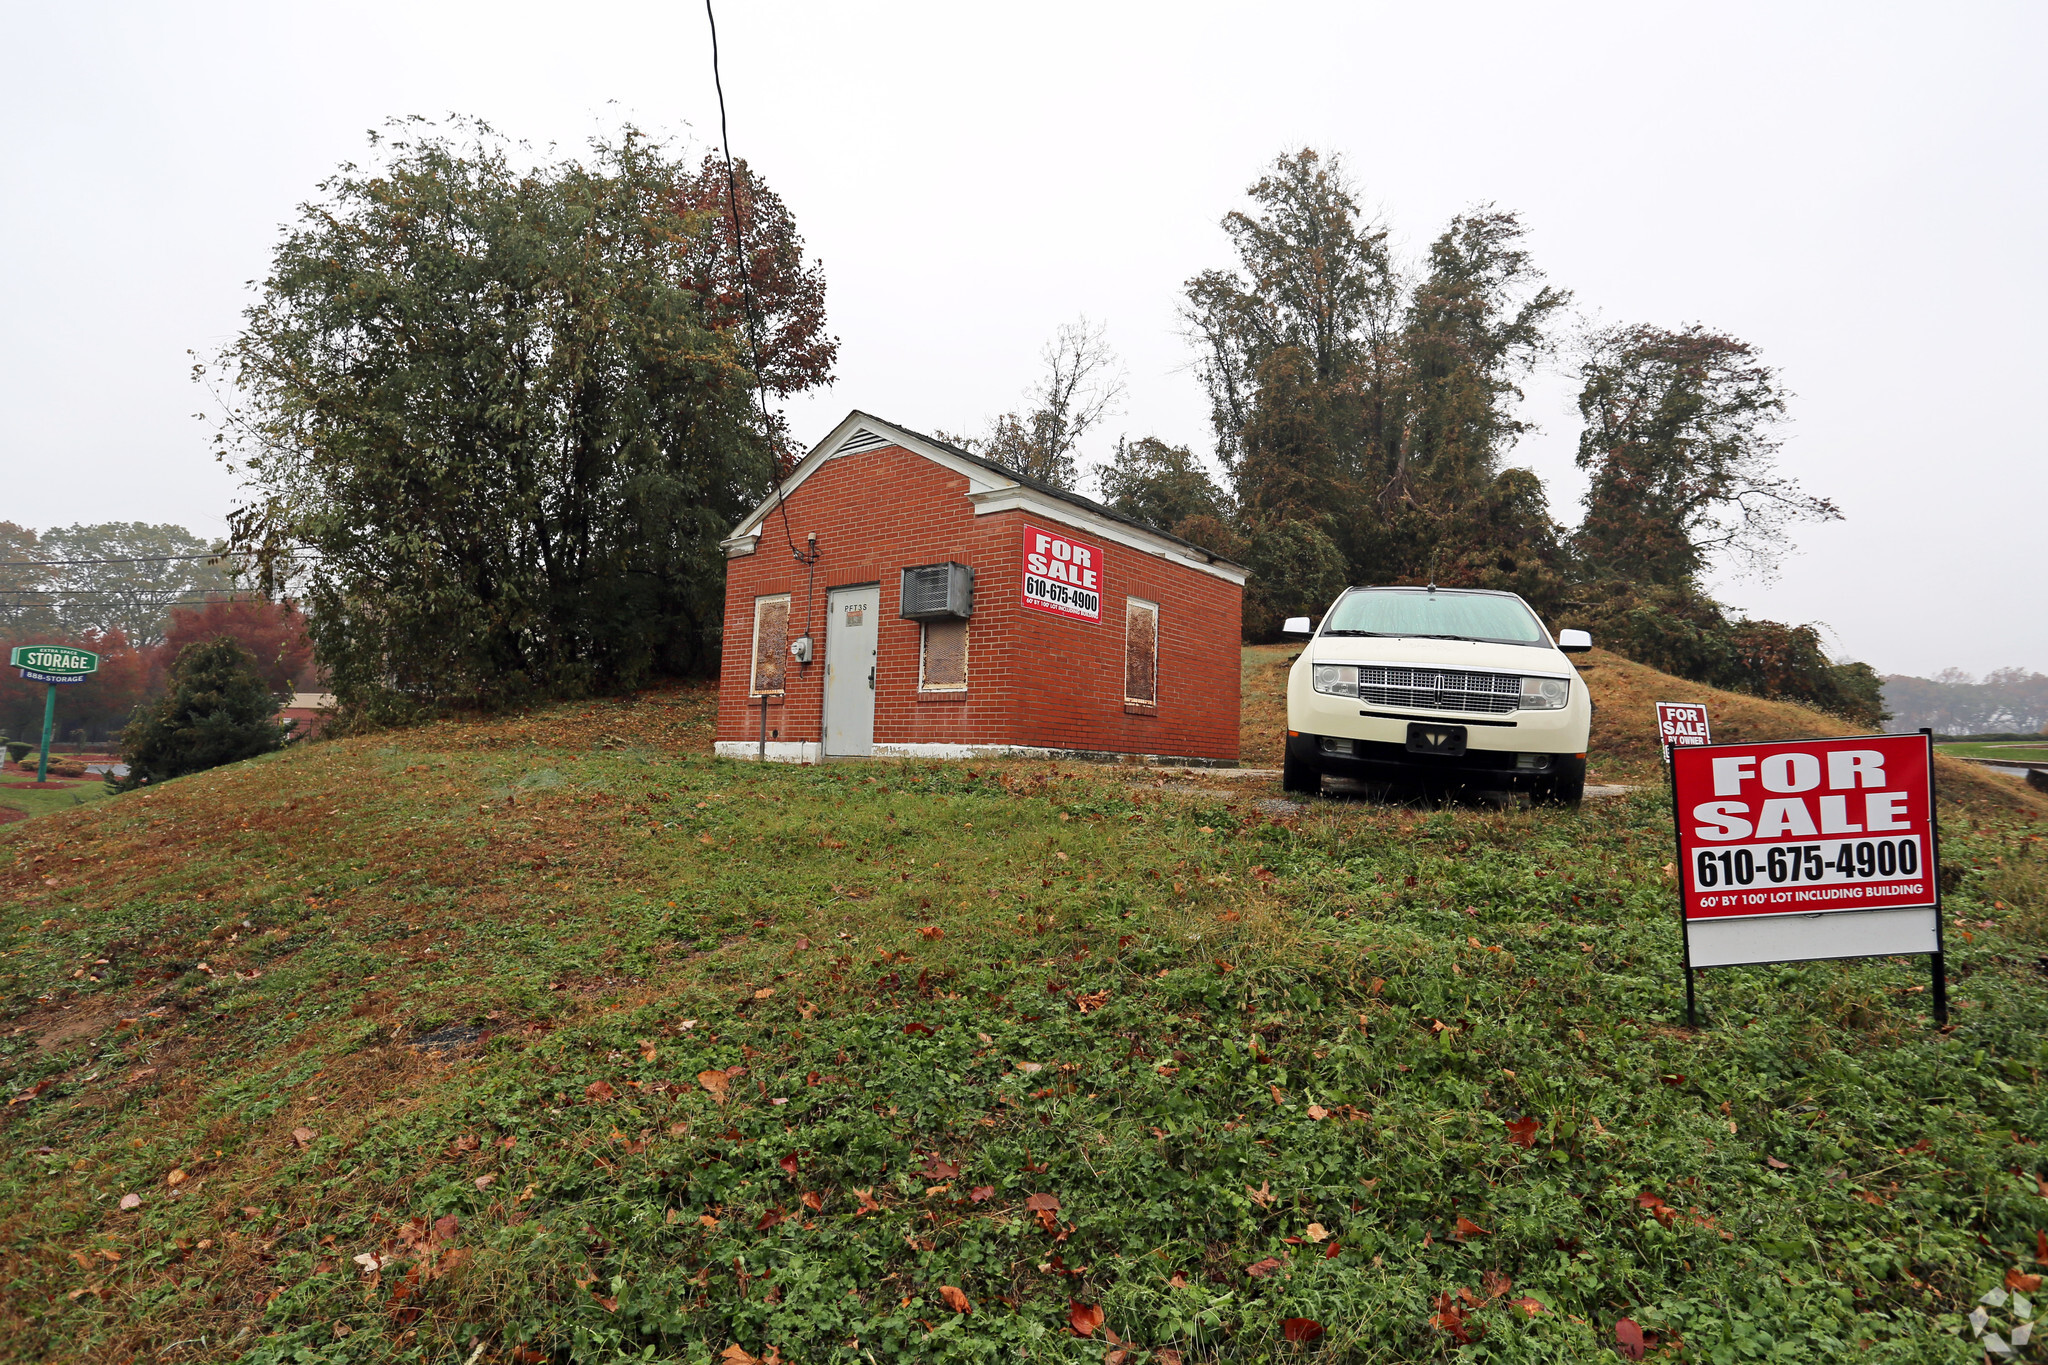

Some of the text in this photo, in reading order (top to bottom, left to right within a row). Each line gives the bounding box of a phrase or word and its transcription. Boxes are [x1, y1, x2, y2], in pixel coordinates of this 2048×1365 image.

[1036, 533, 1091, 568] FOR
[1027, 553, 1097, 589] SALE
[1026, 577, 1097, 612] 610-675-4900
[27, 652, 89, 669] STORAGE
[26, 671, 84, 682] 888-STORAGE
[1662, 721, 1706, 736] SALE
[1666, 708, 1698, 721] FOR
[1668, 736, 1704, 745] BY OWNER
[1712, 750, 1886, 796] FOR
[1692, 791, 1911, 841] SALE
[1697, 839, 1918, 888] 610-675-4900
[1699, 884, 1924, 908] 60' BY 100' LOT INCLUDING BUILDING
